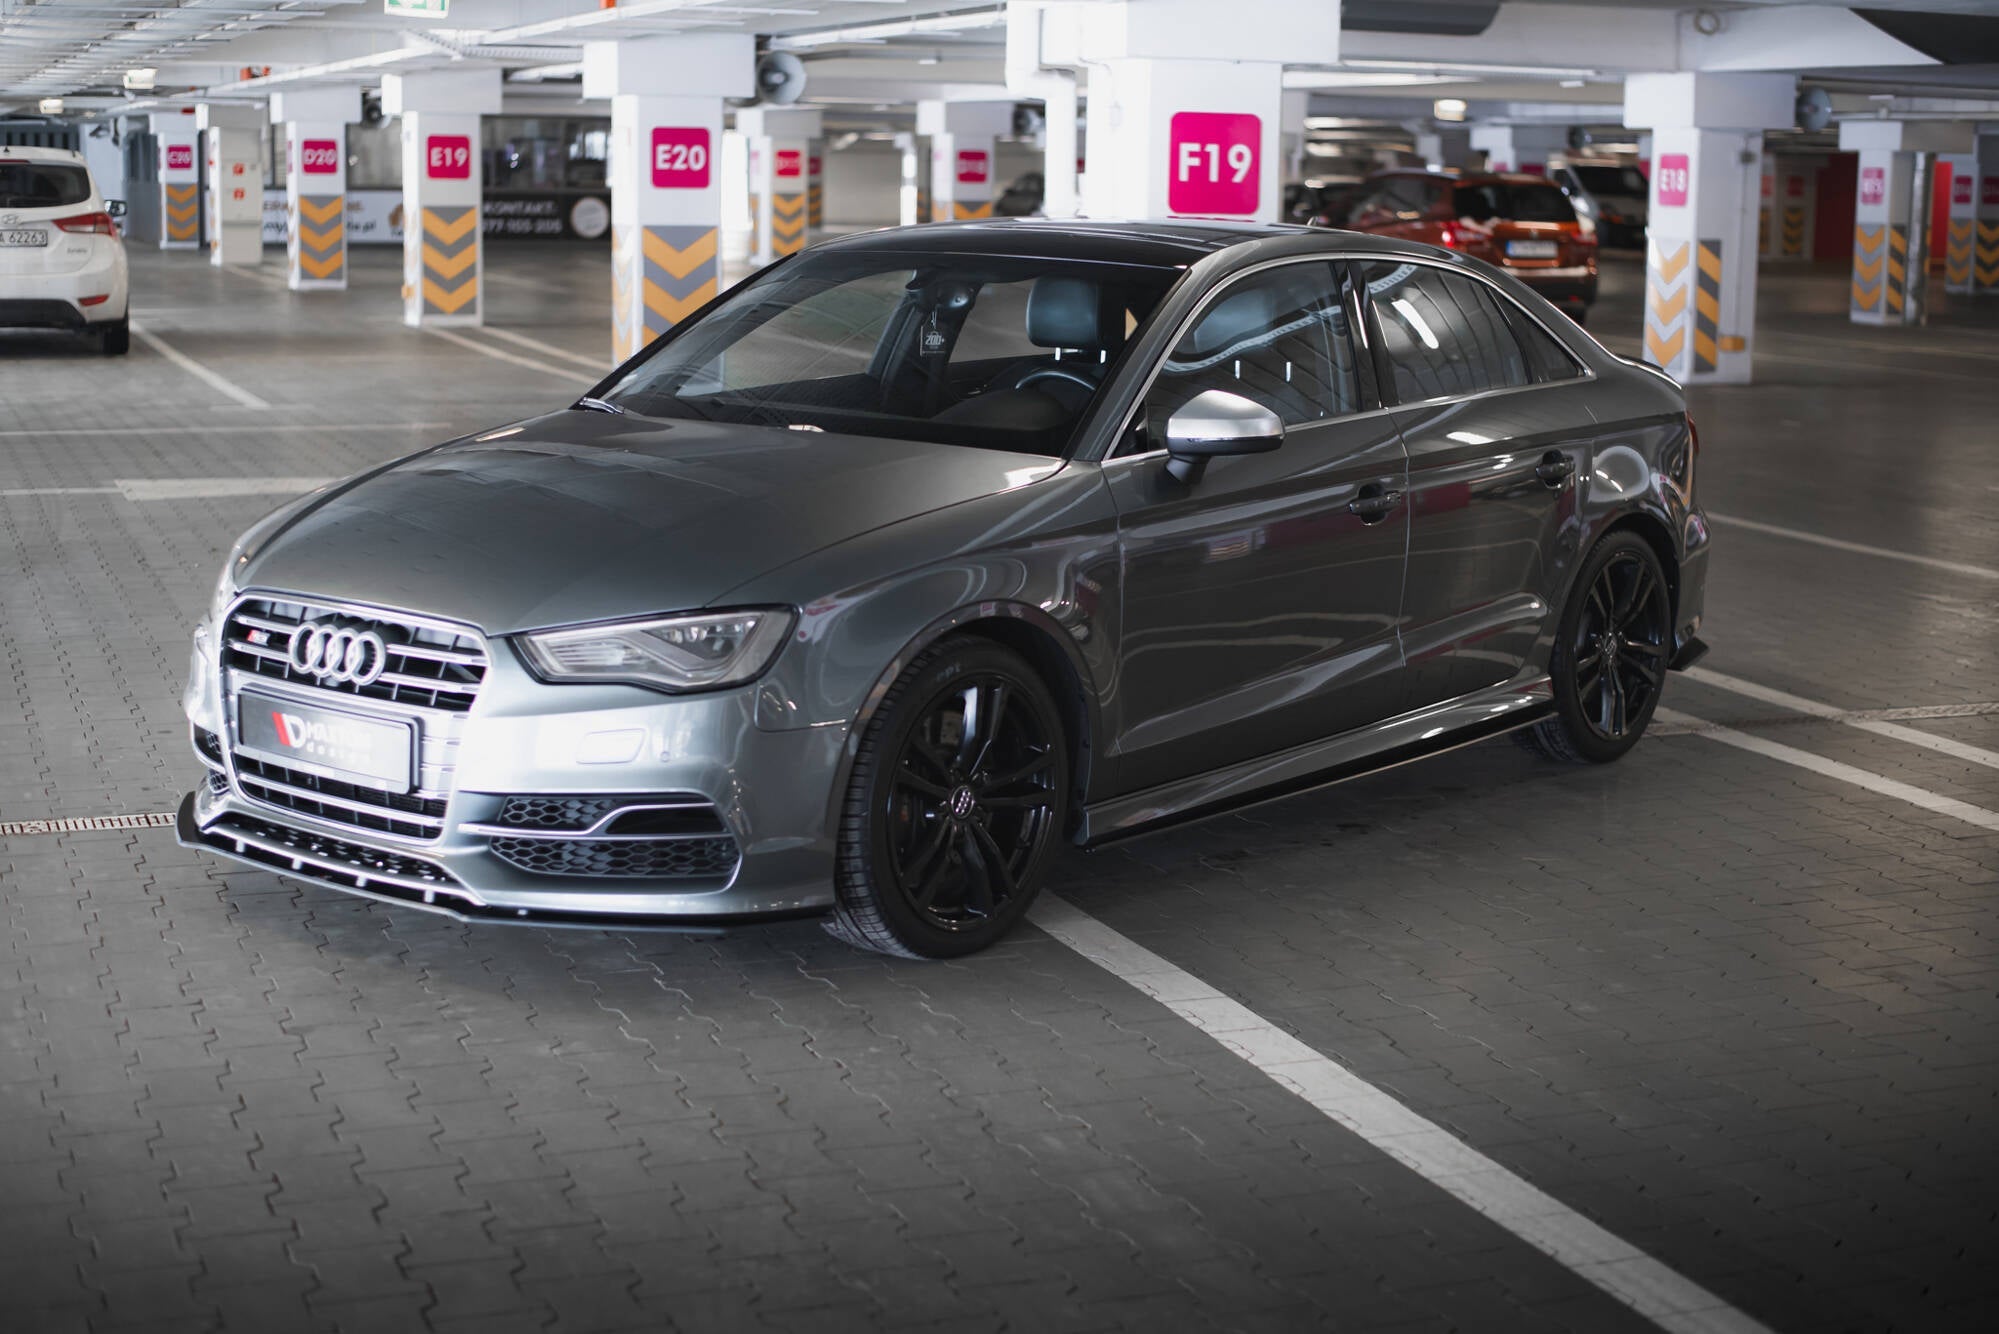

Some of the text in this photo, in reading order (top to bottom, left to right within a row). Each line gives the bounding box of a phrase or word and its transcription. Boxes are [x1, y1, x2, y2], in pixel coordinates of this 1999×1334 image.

[303, 148, 336, 166] D20
[430, 147, 468, 167] E19
[655, 144, 707, 172] E20
[1178, 142, 1253, 184] F19
[1660, 167, 1687, 192] E18
[9, 231, 45, 244] 62263
